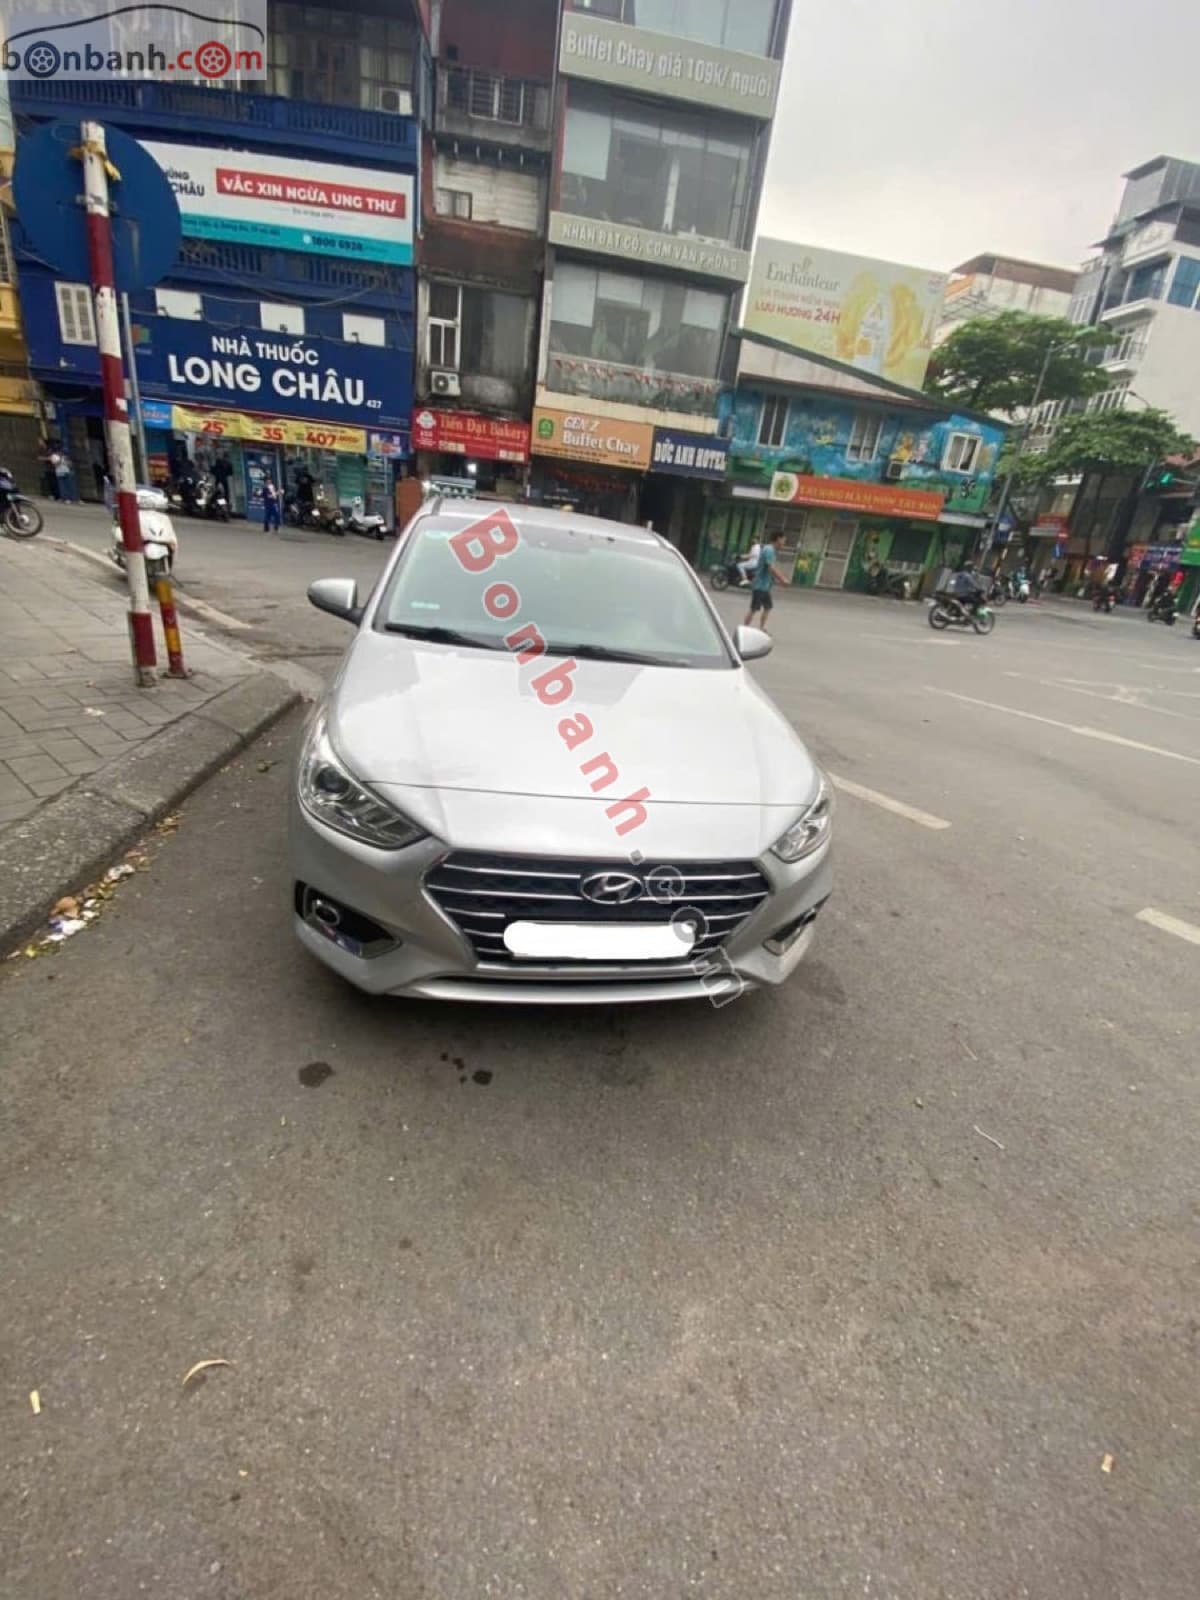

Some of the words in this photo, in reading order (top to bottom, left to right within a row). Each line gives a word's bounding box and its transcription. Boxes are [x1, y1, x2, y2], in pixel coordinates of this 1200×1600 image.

[567, 30, 612, 62] Buffet
[617, 39, 653, 72] Chay
[658, 51, 681, 78] giá
[222, 175, 253, 194] VẮC
[257, 182, 283, 198] XIN
[286, 186, 328, 204] NGỪA
[331, 192, 362, 208] UNG
[365, 198, 397, 213] THƯ
[814, 307, 841, 325] 24H
[211, 335, 252, 357] NHÀ
[256, 341, 319, 366] THUỐC
[168, 354, 261, 392] LONG
[272, 368, 365, 406] CHÂU
[562, 430, 604, 449] Buffet
[606, 436, 641, 457] Chay
